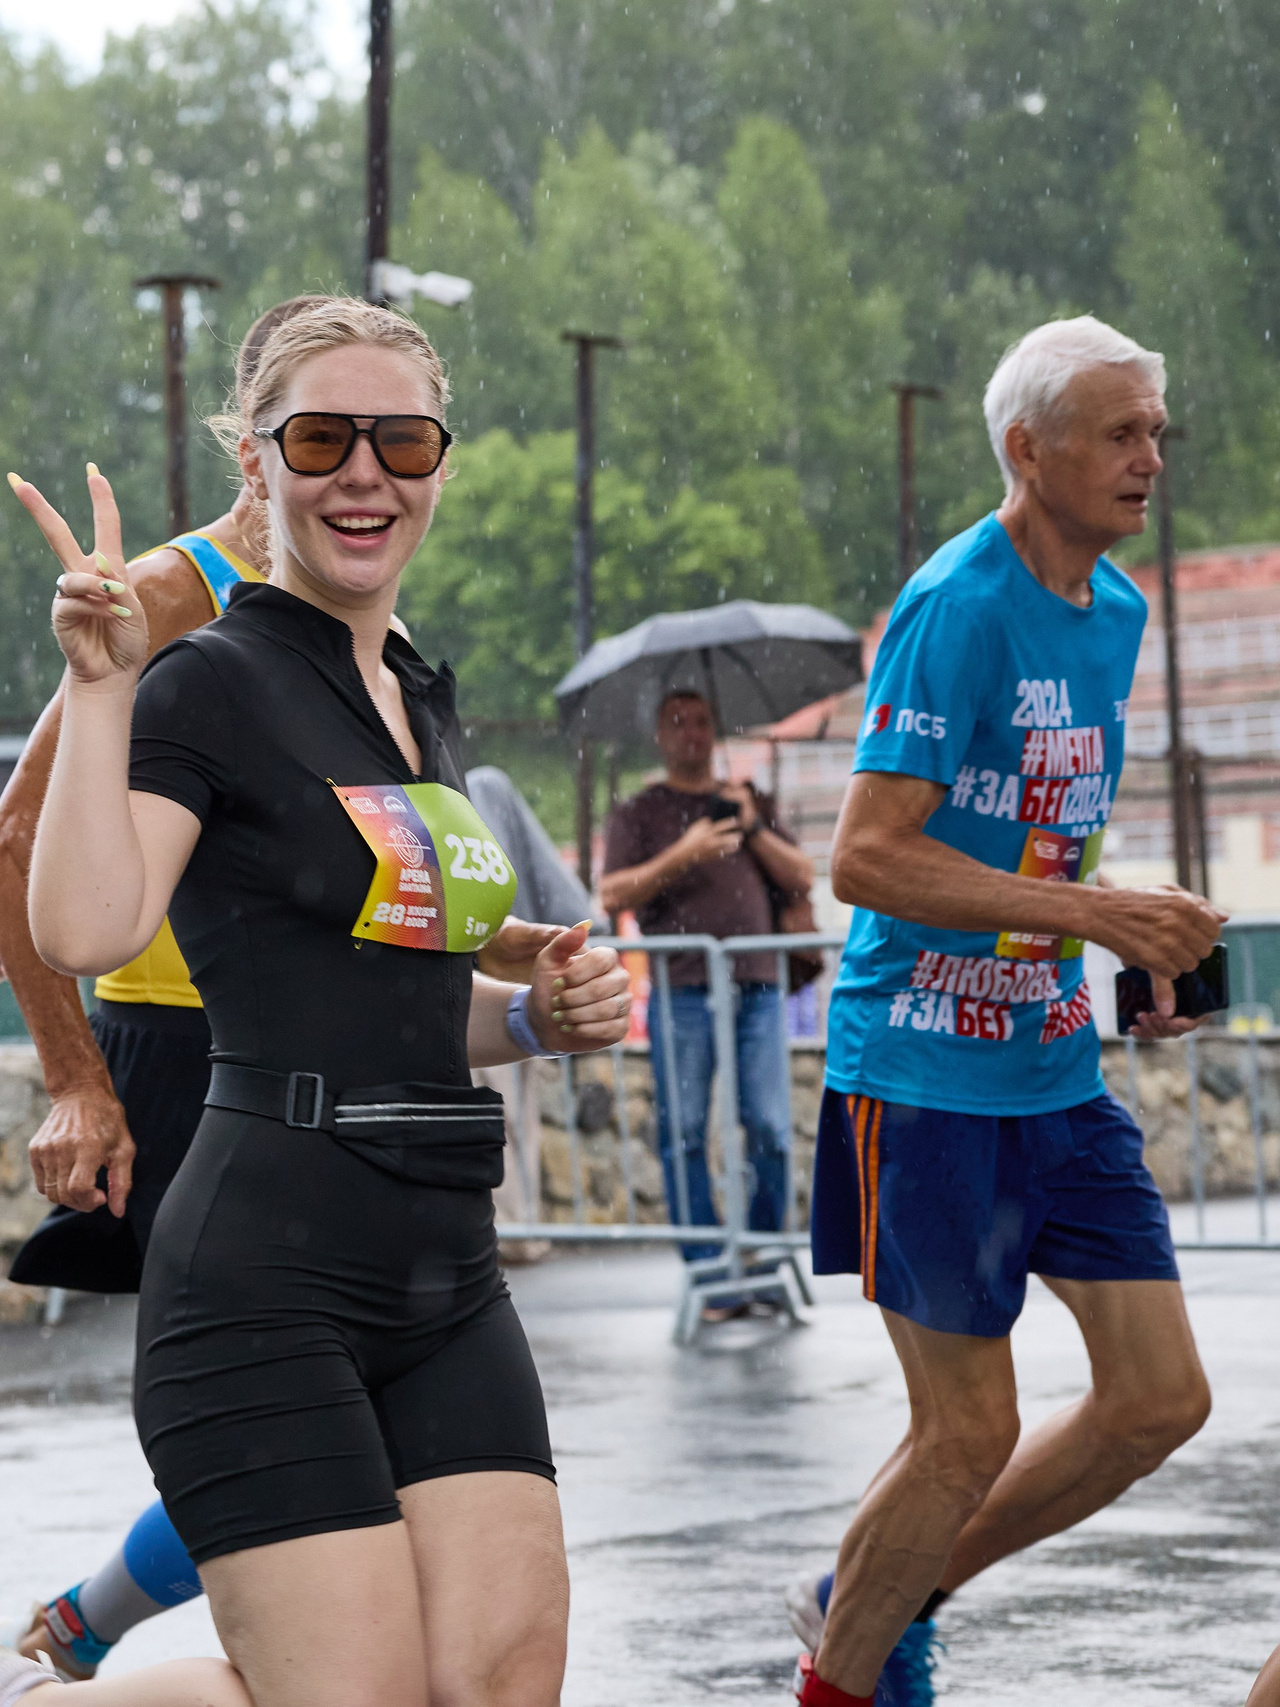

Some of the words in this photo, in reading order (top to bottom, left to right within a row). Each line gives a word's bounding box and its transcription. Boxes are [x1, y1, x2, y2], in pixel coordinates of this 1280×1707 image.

[1011, 678, 1073, 728] 2024
[895, 708, 947, 740] ПСБ
[1020, 727, 1105, 778] #МЕЧТА
[400, 868, 431, 884] АРЕНА
[444, 833, 510, 886] 238
[372, 902, 406, 925] 28
[465, 916, 475, 936] 5
[910, 950, 1062, 1004] #ЛЮБОВЬ
